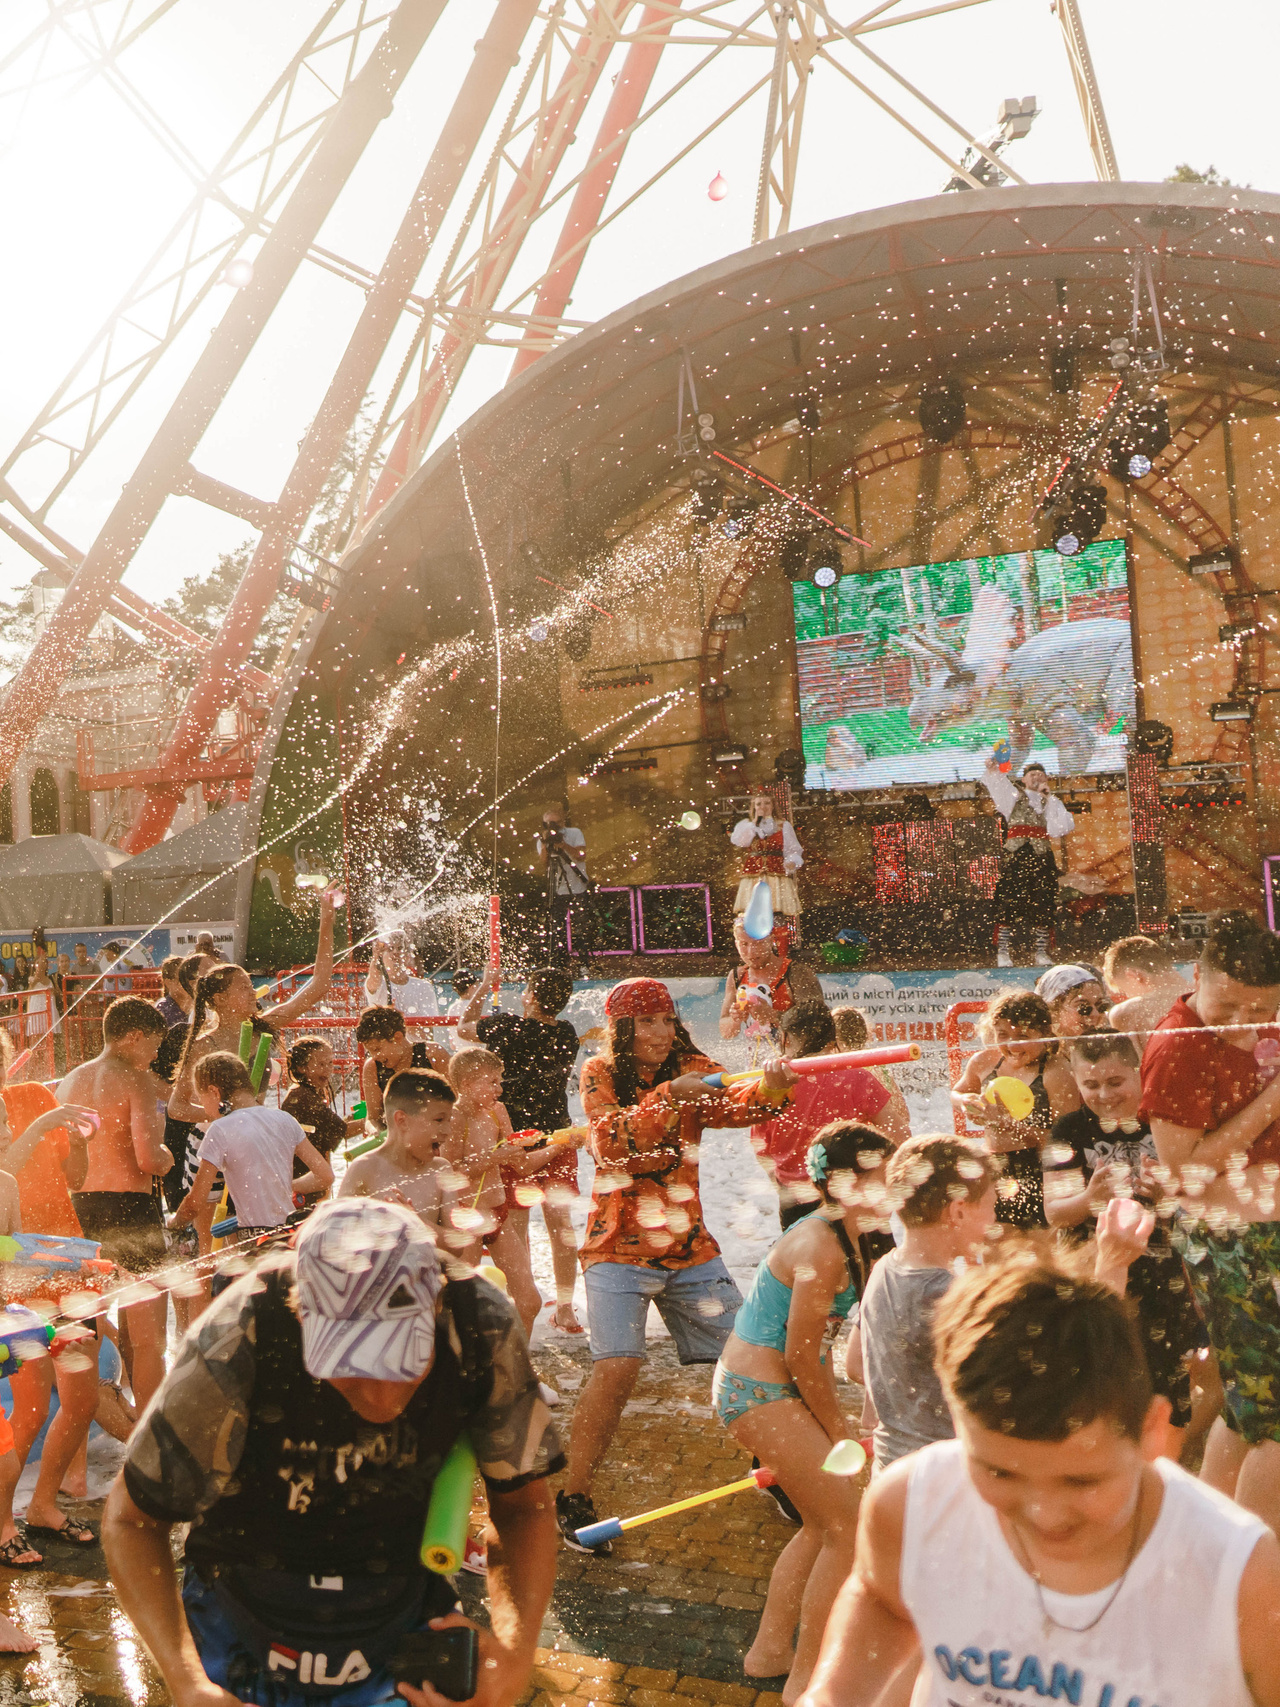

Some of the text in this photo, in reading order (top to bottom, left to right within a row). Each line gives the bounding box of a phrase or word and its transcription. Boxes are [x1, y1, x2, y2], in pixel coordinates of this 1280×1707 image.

[1, 941, 58, 959] ОСВІИ
[863, 988, 894, 1000] місті
[889, 1003, 916, 1016] усіх
[268, 1642, 372, 1686] FILA
[934, 1643, 1084, 1706] OCEAN
